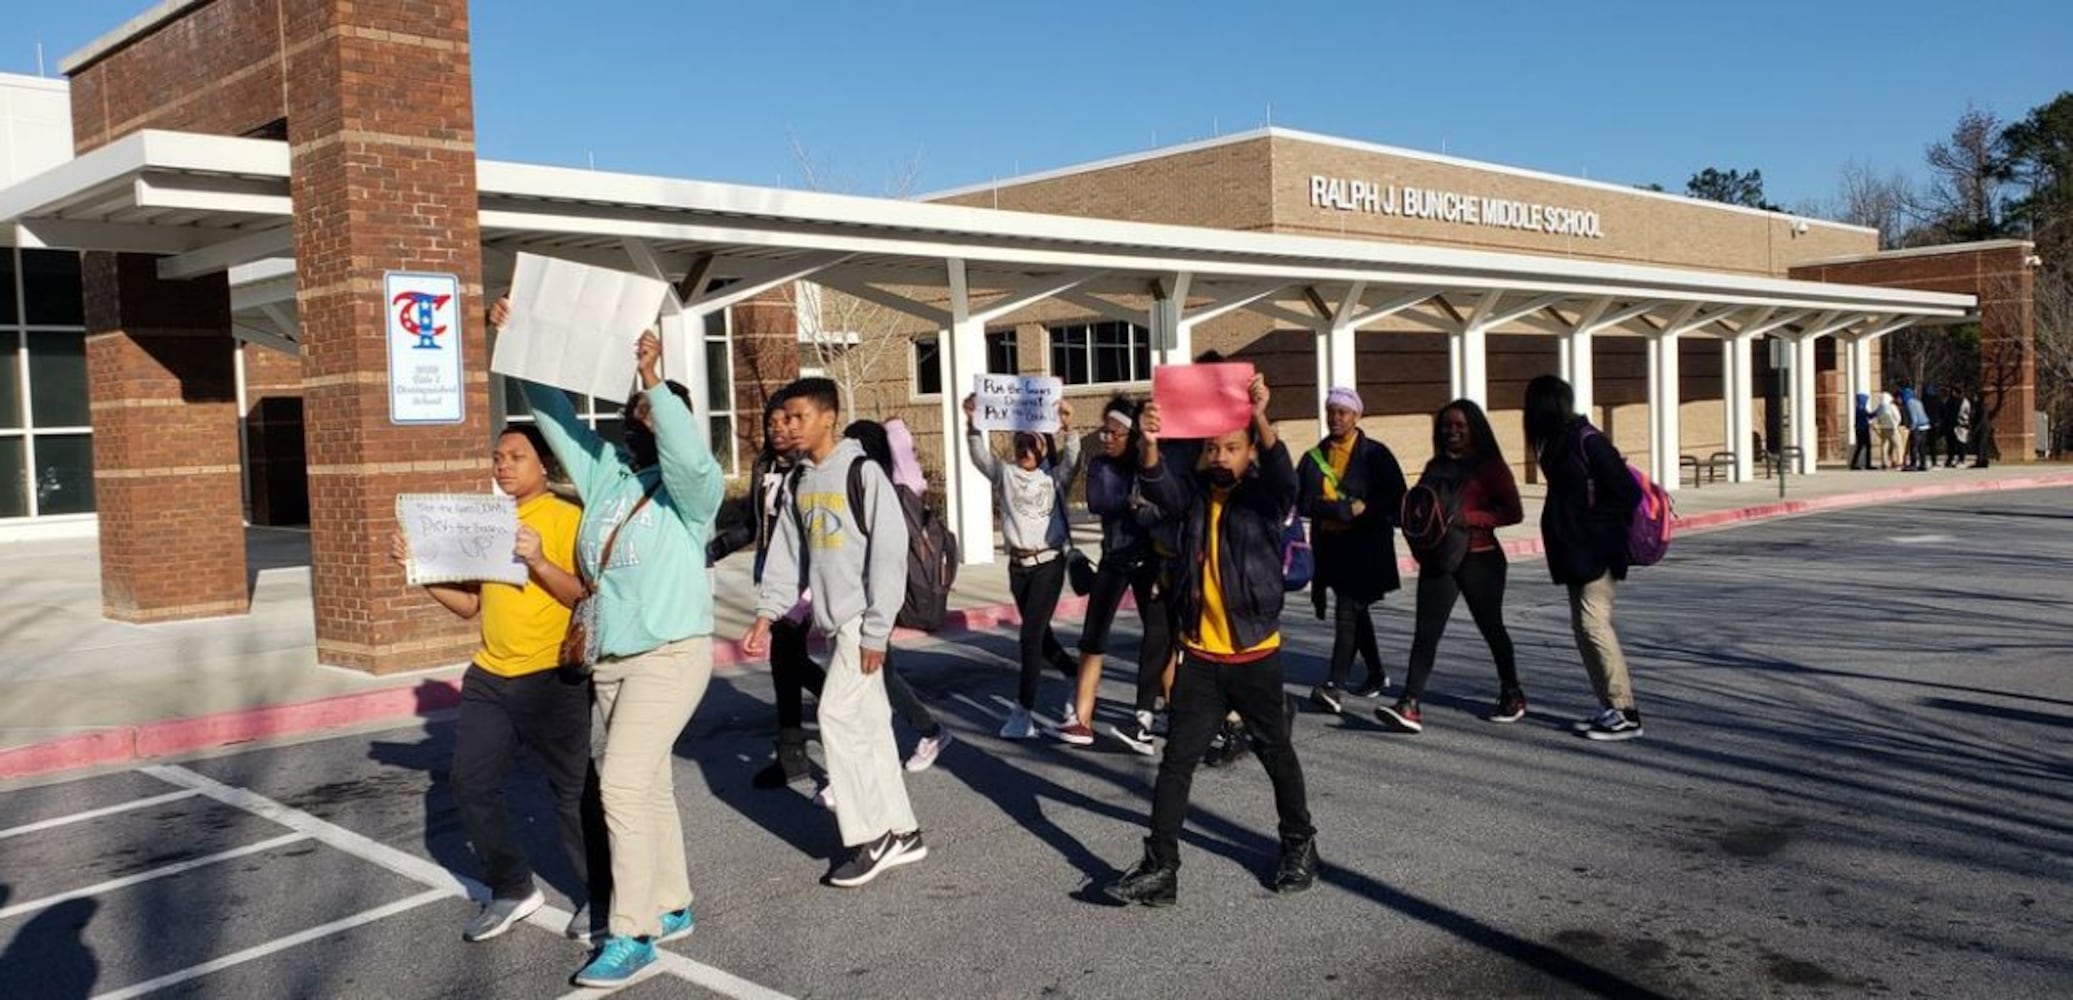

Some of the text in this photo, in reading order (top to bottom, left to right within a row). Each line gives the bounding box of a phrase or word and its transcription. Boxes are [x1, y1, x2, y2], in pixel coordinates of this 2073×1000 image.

[1309, 175, 1604, 238] RALPH J. BUNCHE MIDDLE SCHOOL
[396, 385, 457, 394] Distinguished
